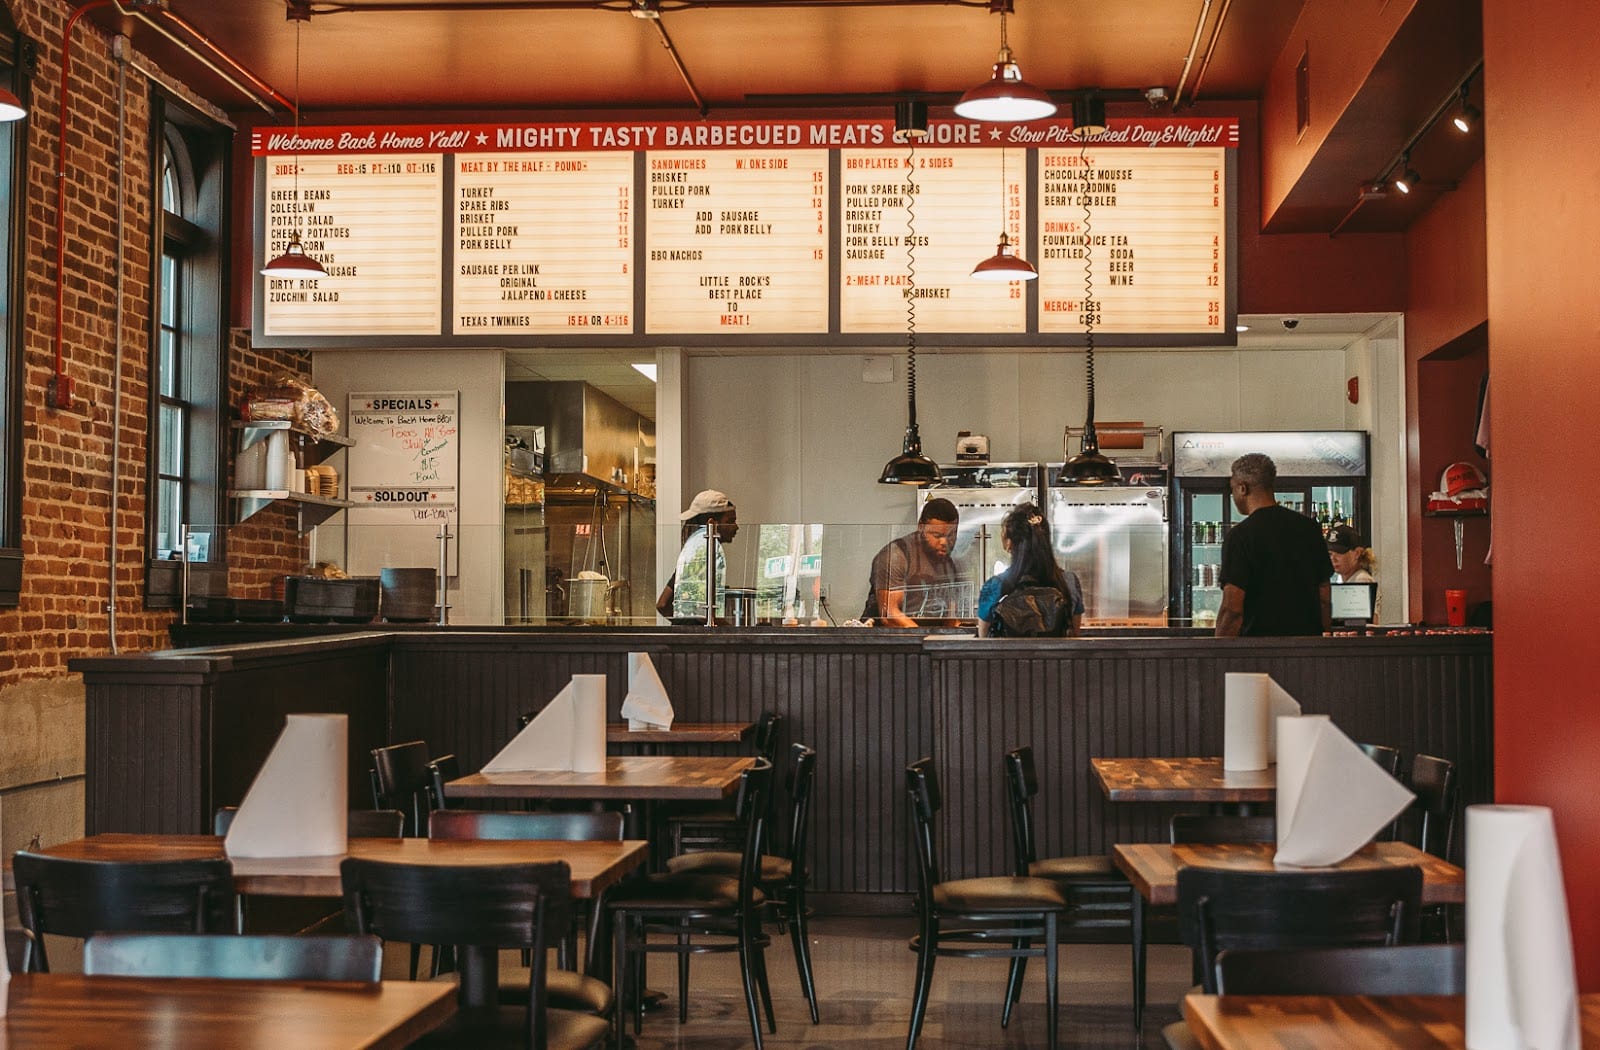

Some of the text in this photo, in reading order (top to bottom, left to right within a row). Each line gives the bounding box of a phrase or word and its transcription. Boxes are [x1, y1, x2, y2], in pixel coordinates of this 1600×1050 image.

[496, 126, 581, 148] MIGHTY
[589, 125, 658, 147] TASTY
[665, 123, 801, 146] BARBECUED
[809, 123, 885, 145] MEATS
[916, 123, 982, 144] MORE
[1007, 125, 1044, 143] Slow
[267, 129, 470, 151] Welcome Back Home Y'all!
[461, 162, 484, 173] MEAT
[487, 161, 498, 173] BY
[503, 161, 519, 172] THE
[651, 159, 706, 170] SANDWICHES
[749, 158, 766, 169] ONE
[769, 158, 788, 169] SIDE
[847, 158, 953, 169] BBQ PLATES 2 SIDES
[651, 171, 823, 183] BRISKET 15
[1044, 169, 1219, 181] CHOCOLATE MOUSSE 6
[461, 187, 629, 198] TURKEY 11
[652, 185, 823, 196] PULLED PORK 11
[846, 185, 868, 195] PORK
[871, 185, 901, 195] SPARE
[1009, 184, 1019, 194] 16
[1044, 183, 1078, 193] BANANA
[1213, 183, 1219, 194] 6
[271, 190, 331, 201] GREEN BEANS
[460, 200, 629, 211] SPARE RIBS 12
[652, 198, 822, 209] TURKEY 13
[847, 197, 1020, 208] PULLED PORK 15
[1044, 196, 1219, 207] BERRY COBBLER 6
[270, 202, 315, 213] COLESLAW
[271, 215, 334, 226] POTATO SALAD
[460, 212, 629, 224] BRISKET 17
[696, 211, 823, 222] ADD SAUSAGE 3
[846, 210, 1020, 221] BRISKET 20
[271, 228, 350, 239] CHEEY POTATOES
[460, 225, 629, 237] PULLED PORK 11
[695, 224, 823, 235] ADD PORK BELLY 4
[847, 223, 1020, 234] TURKEY 15
[303, 241, 325, 251] CORN
[460, 238, 629, 250] PORK BELLY 15
[846, 236, 868, 247] PORK
[872, 236, 899, 247] BELLY
[1043, 235, 1084, 246] FOUNTAIN
[1092, 235, 1107, 246] ICE
[1111, 235, 1129, 246] TEA
[1213, 235, 1219, 246] 4
[651, 250, 823, 262] BBQ NACHOS 15
[846, 250, 885, 260] SAUSAGE
[1044, 248, 1219, 259] BOTTLED SODA 5
[325, 266, 357, 277] AUSAGE
[461, 263, 628, 275] SAUSAGE PER LINK 6
[1109, 261, 1219, 273] BEER 6
[270, 279, 319, 290] DIRTY RICE
[500, 277, 537, 288] ORIGINAL
[700, 276, 770, 287] LITTLE ROCK'S
[1109, 275, 1219, 286] WINE 12
[270, 292, 339, 303] ZUCCHINI SALAD
[501, 289, 545, 300] JALAPENO
[553, 290, 587, 300] CHEESE
[709, 289, 762, 300] BEST PLACE
[1009, 288, 1021, 299] 26
[727, 302, 738, 313] TO
[1208, 302, 1219, 312] 35
[461, 316, 488, 327] TEXAS
[491, 315, 530, 327] TWINKIES
[578, 315, 588, 326] EA
[591, 315, 602, 326] OR
[1079, 314, 1219, 326] CPS 30
[373, 399, 432, 410] SPECIALS
[354, 415, 385, 426] Welcome
[397, 415, 418, 425] Back
[419, 415, 436, 424] Home
